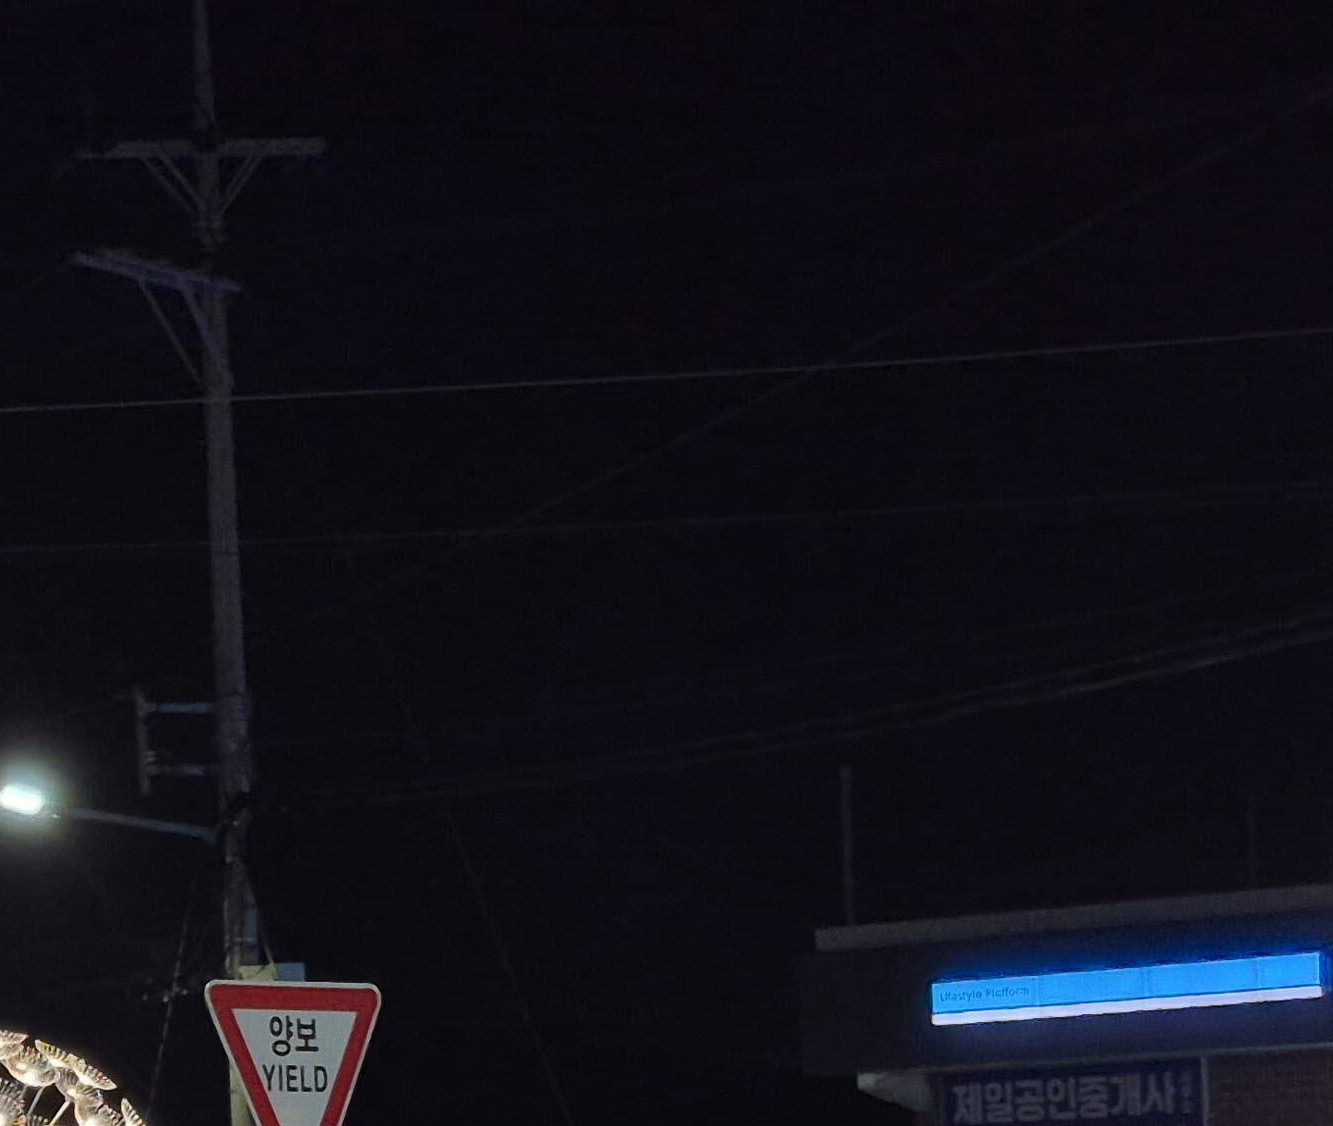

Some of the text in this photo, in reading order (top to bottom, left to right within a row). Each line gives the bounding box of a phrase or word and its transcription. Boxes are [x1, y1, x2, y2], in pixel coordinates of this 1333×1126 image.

[269, 1015, 319, 1056] 양보
[262, 1064, 328, 1093] YIELD
[952, 1071, 1175, 1125] 제일공인중개사
